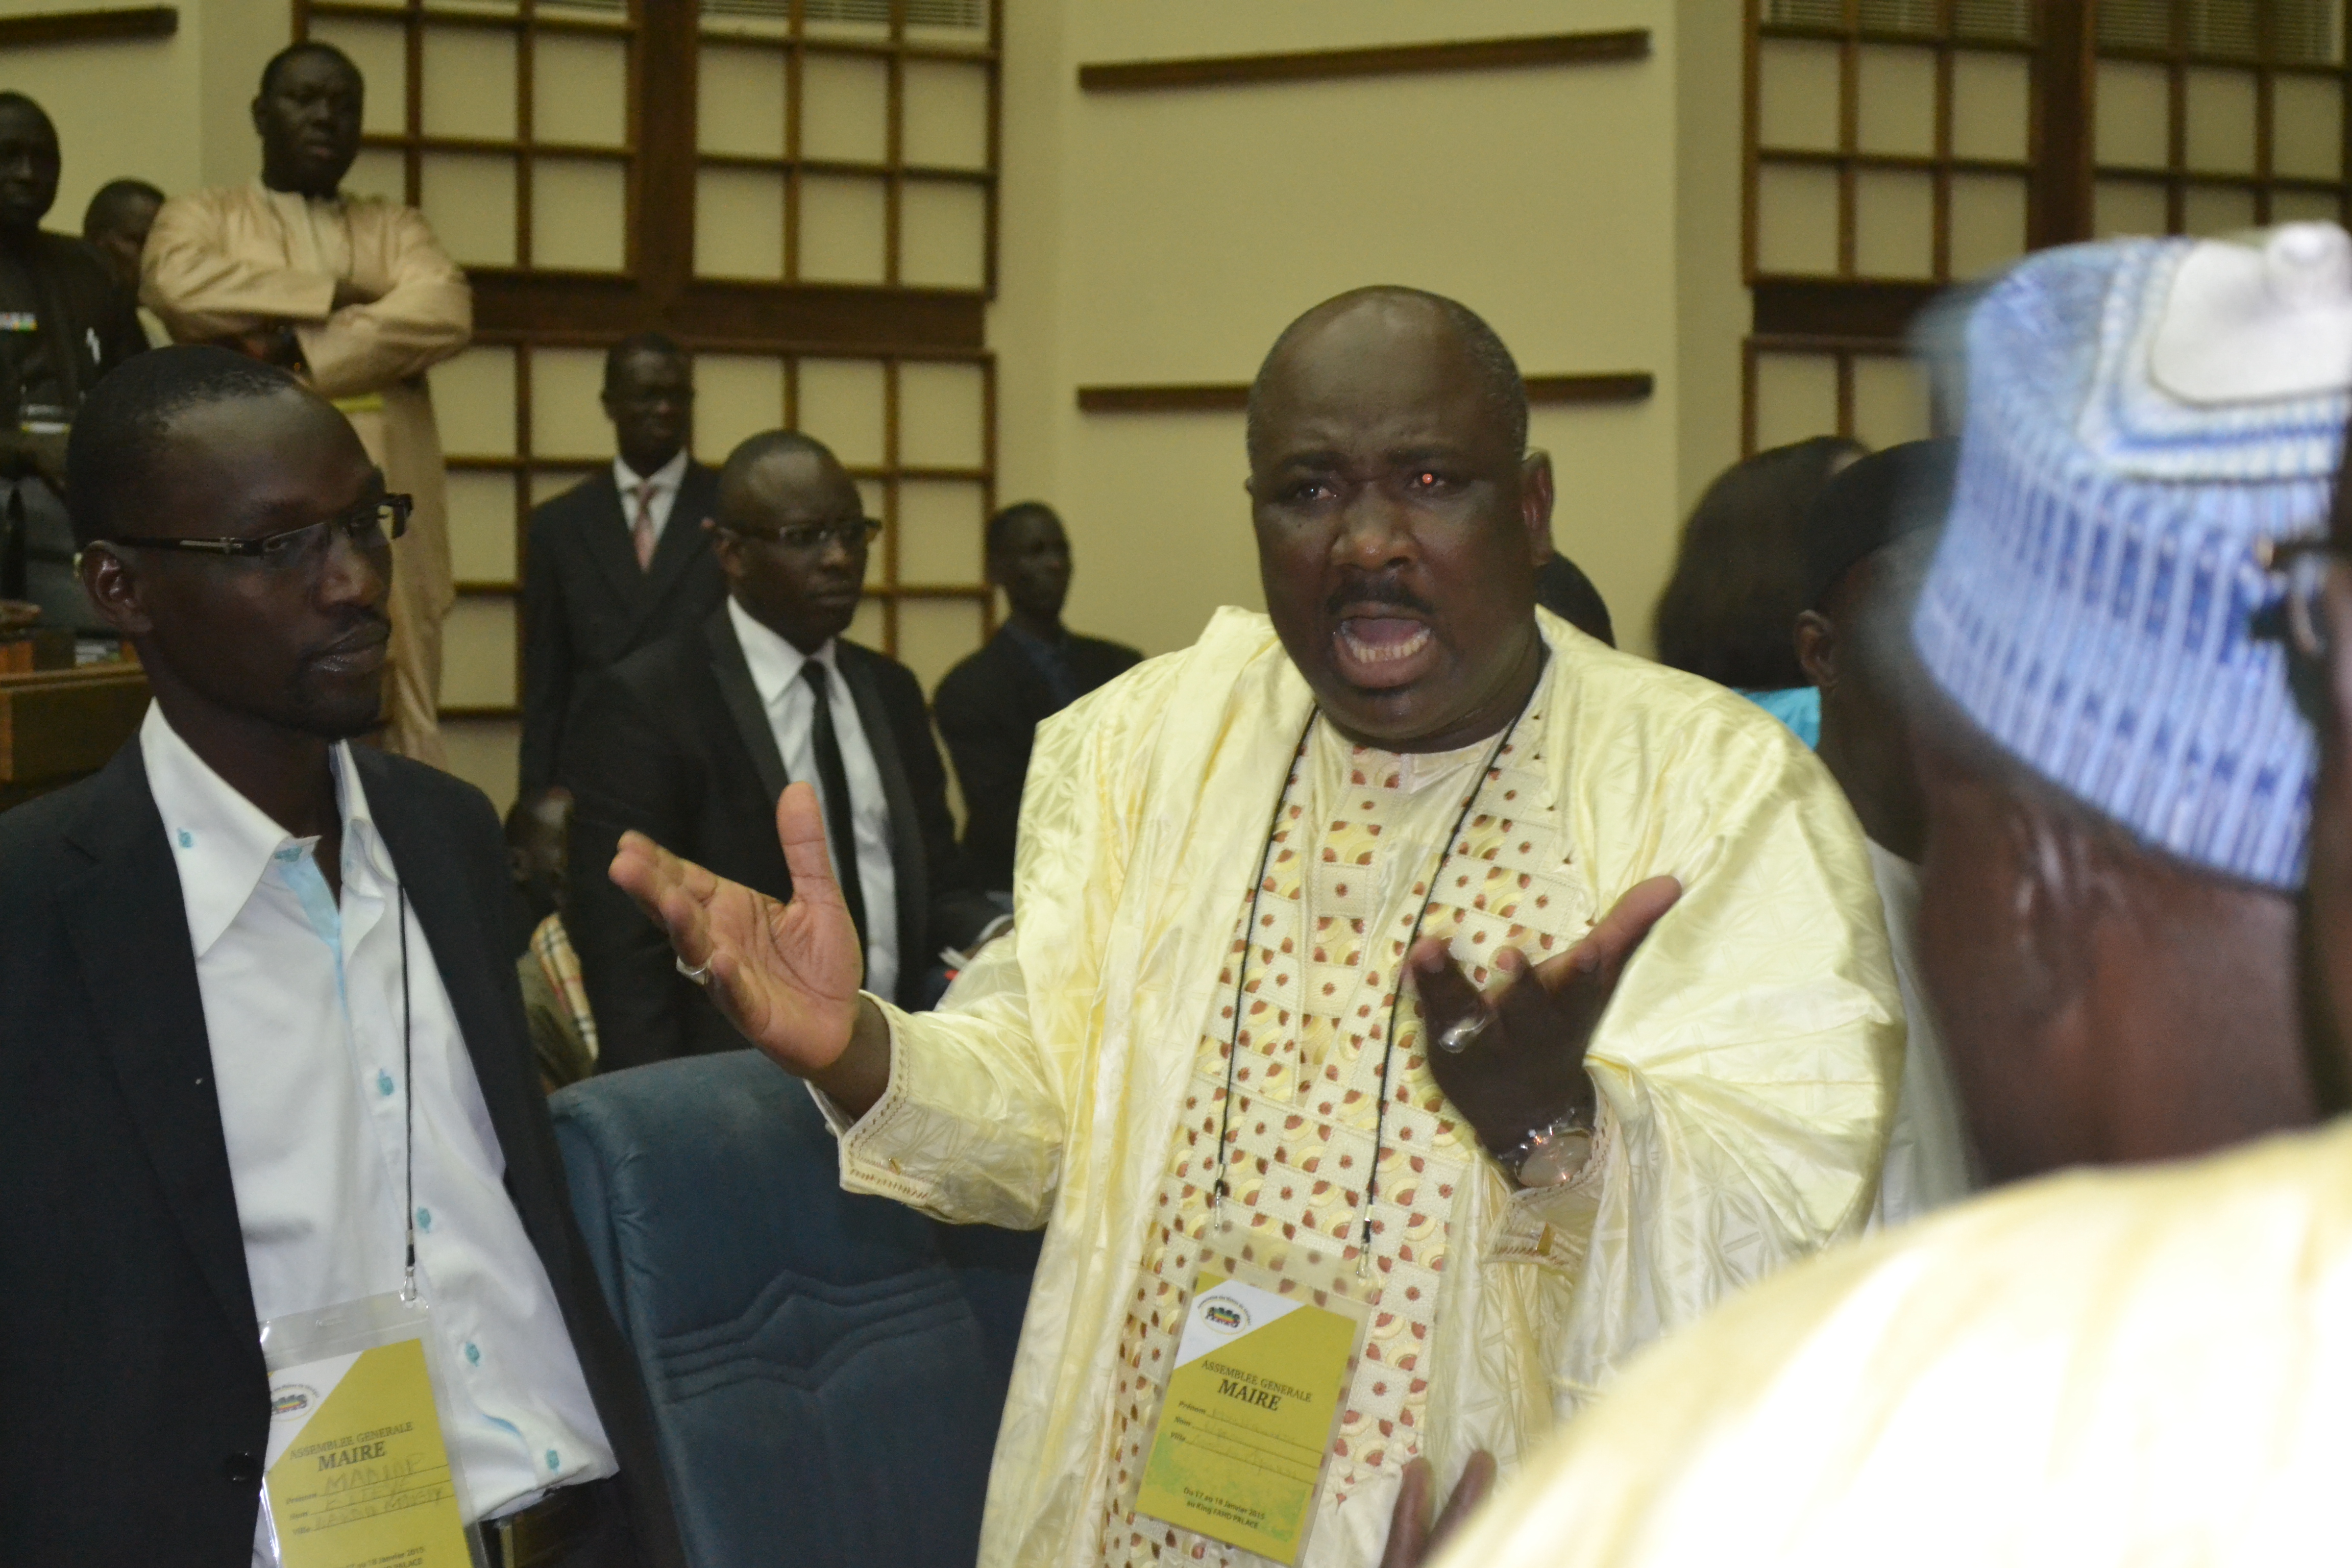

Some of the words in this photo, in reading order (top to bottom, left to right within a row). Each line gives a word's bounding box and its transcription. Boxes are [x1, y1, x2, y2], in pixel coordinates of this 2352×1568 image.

[1202, 1360, 1258, 1385] ASSEMBLEE
[1260, 1379, 1312, 1403] GENERALE
[1217, 1379, 1282, 1411] MAIRE
[357, 1422, 412, 1443] GENERALE
[318, 1441, 385, 1472] MAIRE
[1233, 1515, 1258, 1529] PALACE
[1249, 1509, 1265, 1520] 2015
[406, 1546, 424, 1557] 2015
